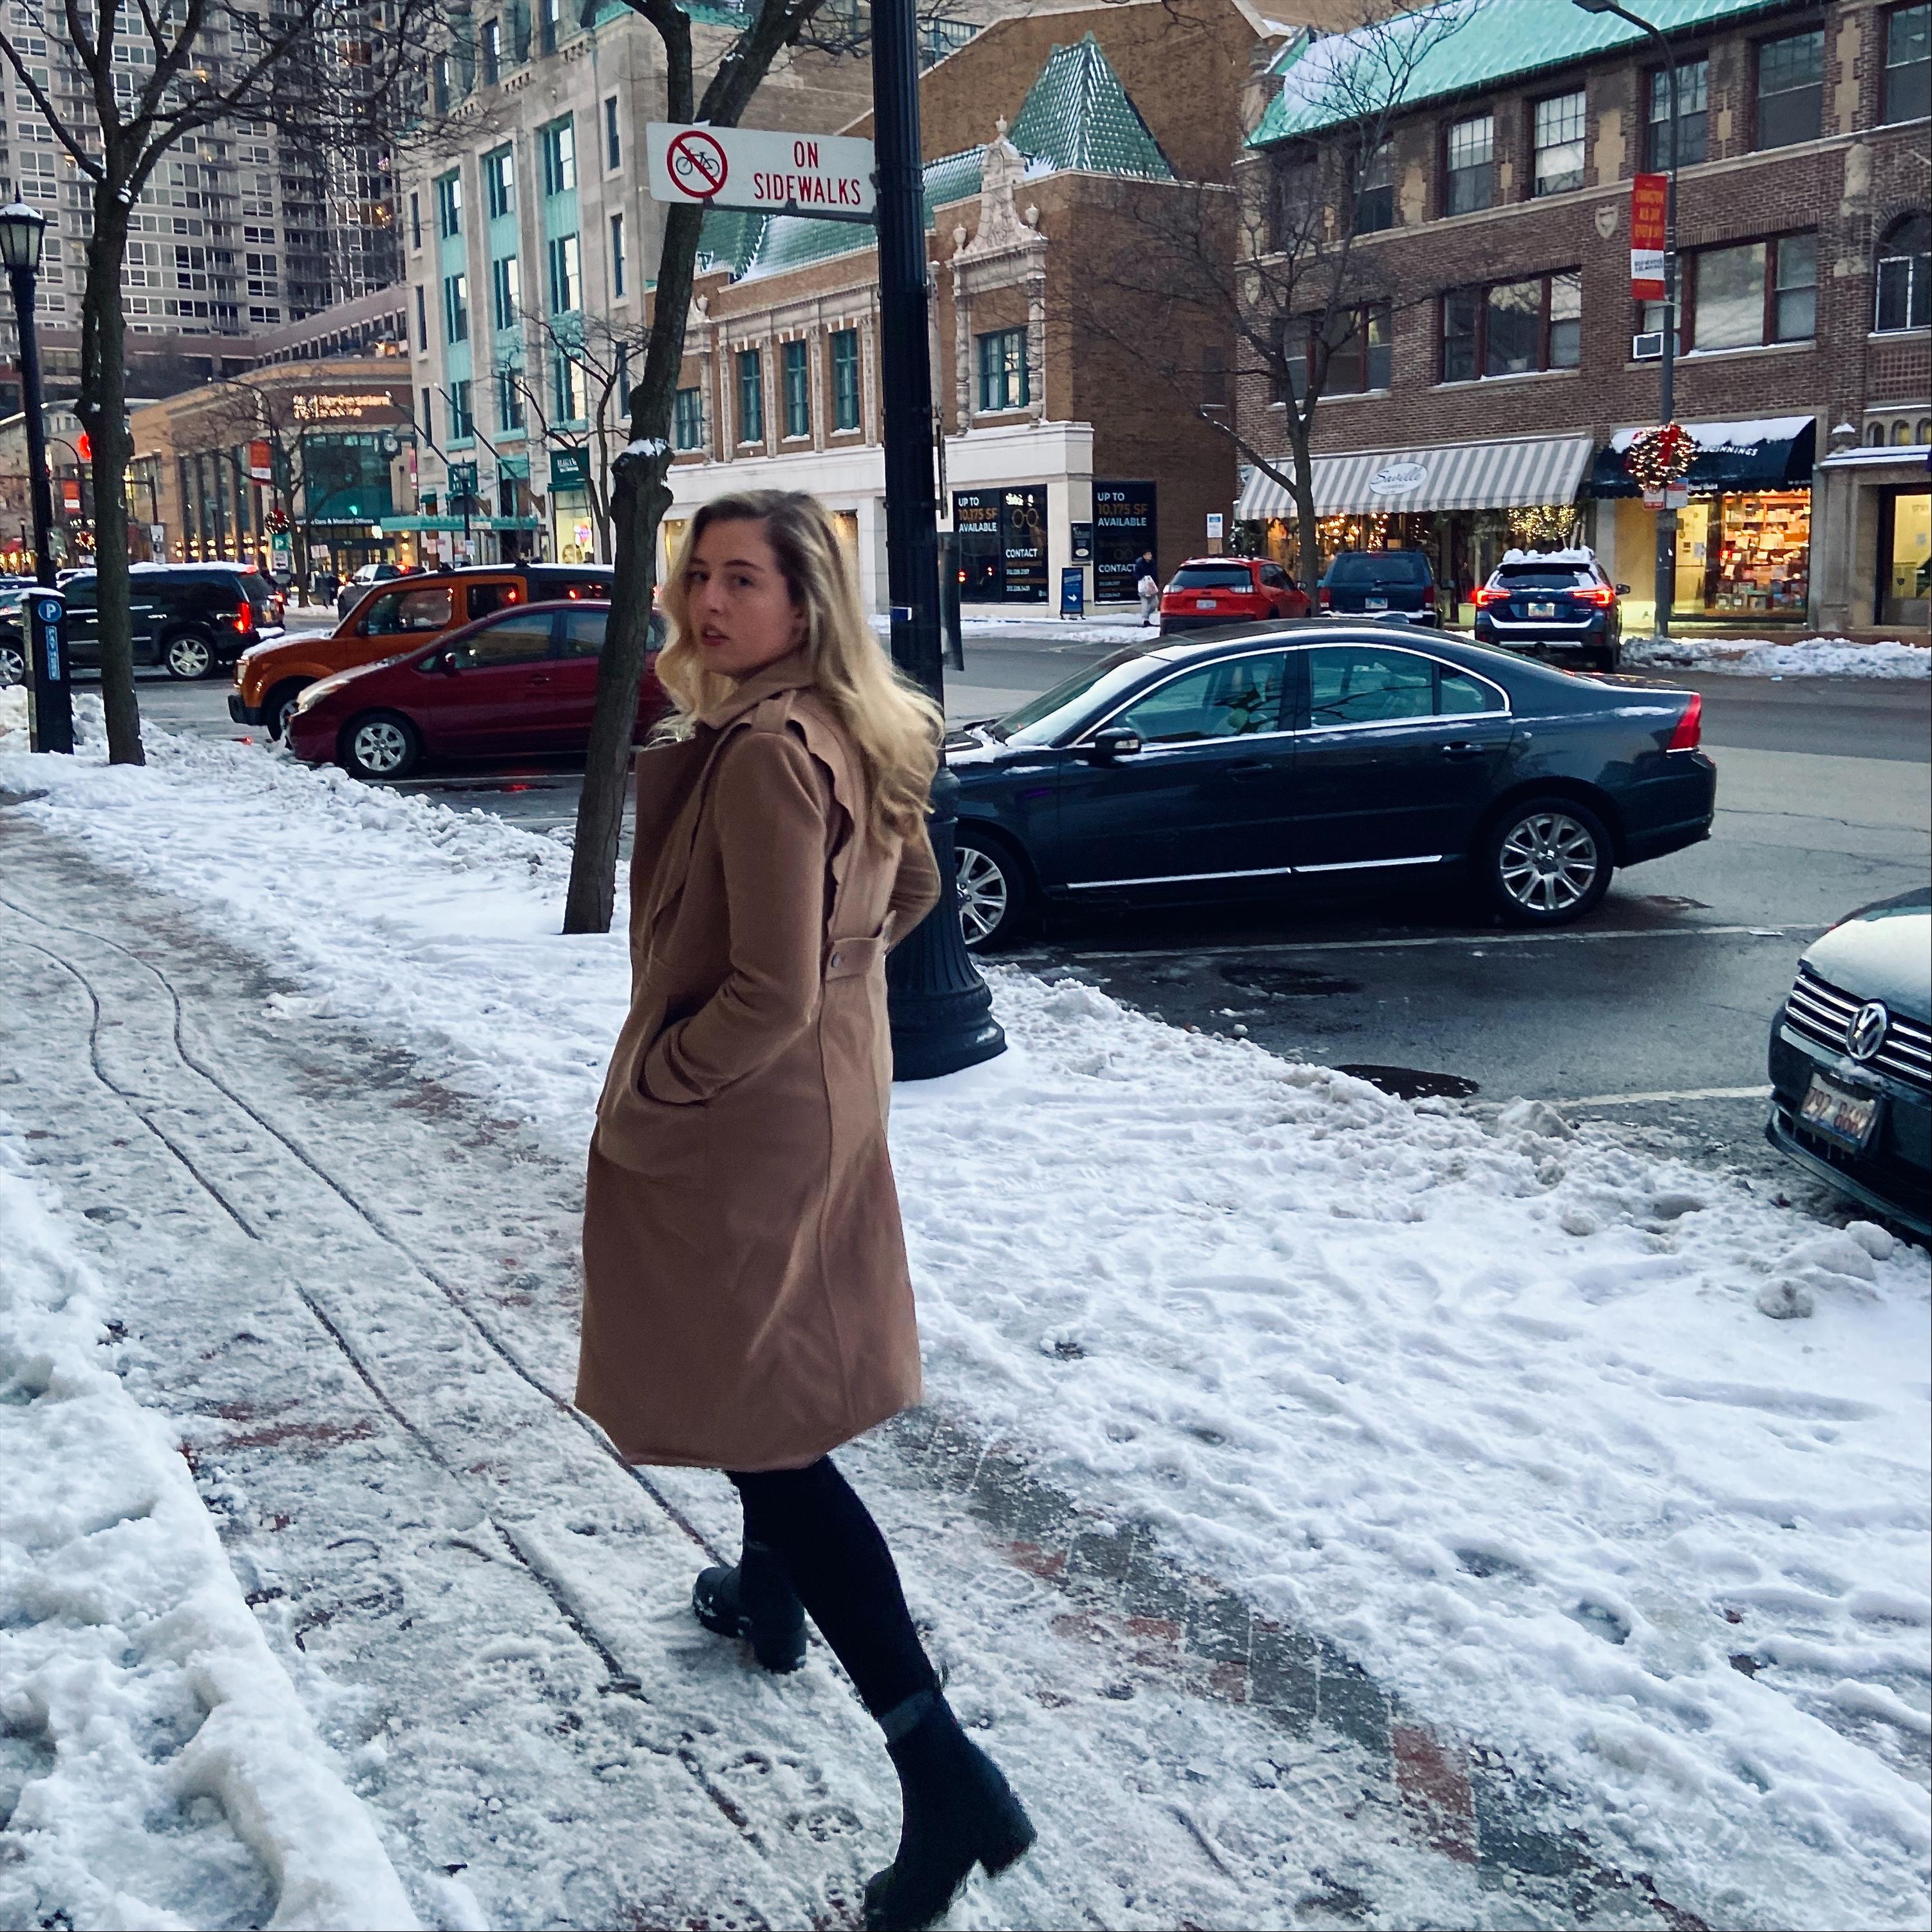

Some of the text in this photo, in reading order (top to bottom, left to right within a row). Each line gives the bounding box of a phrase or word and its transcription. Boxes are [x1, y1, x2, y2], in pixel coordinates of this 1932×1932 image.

[793, 140, 819, 169] ON
[754, 173, 860, 205] SIDEWALKS
[958, 497, 979, 506] UP TO
[1097, 492, 1124, 501] UP TO
[986, 507, 998, 520] SF
[1133, 504, 1148, 515] SF
[1098, 517, 1147, 526] AVAILABLE
[958, 522, 997, 533] AVAILABLE
[1005, 548, 1037, 558] CONTACT
[1098, 564, 1136, 573] CONTACT
[46, 603, 56, 618] P
